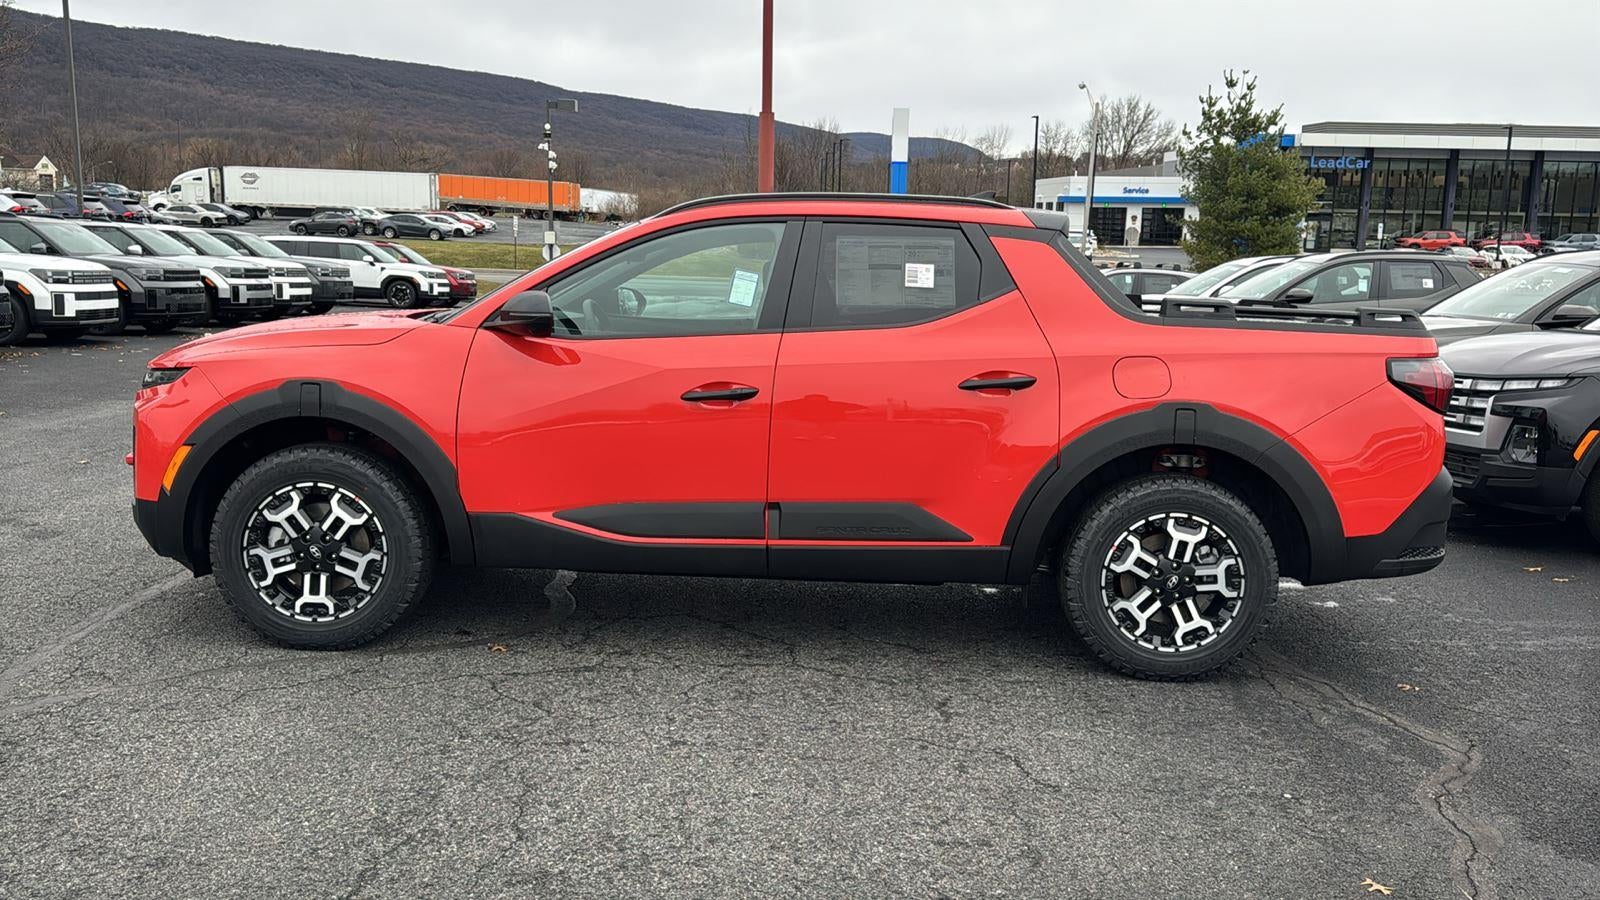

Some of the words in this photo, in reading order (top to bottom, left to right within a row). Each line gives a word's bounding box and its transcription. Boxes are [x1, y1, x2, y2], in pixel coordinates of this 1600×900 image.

[1309, 155, 1371, 170] LeadCar
[1122, 186, 1150, 195] Service
[816, 526, 866, 536] SANTA
